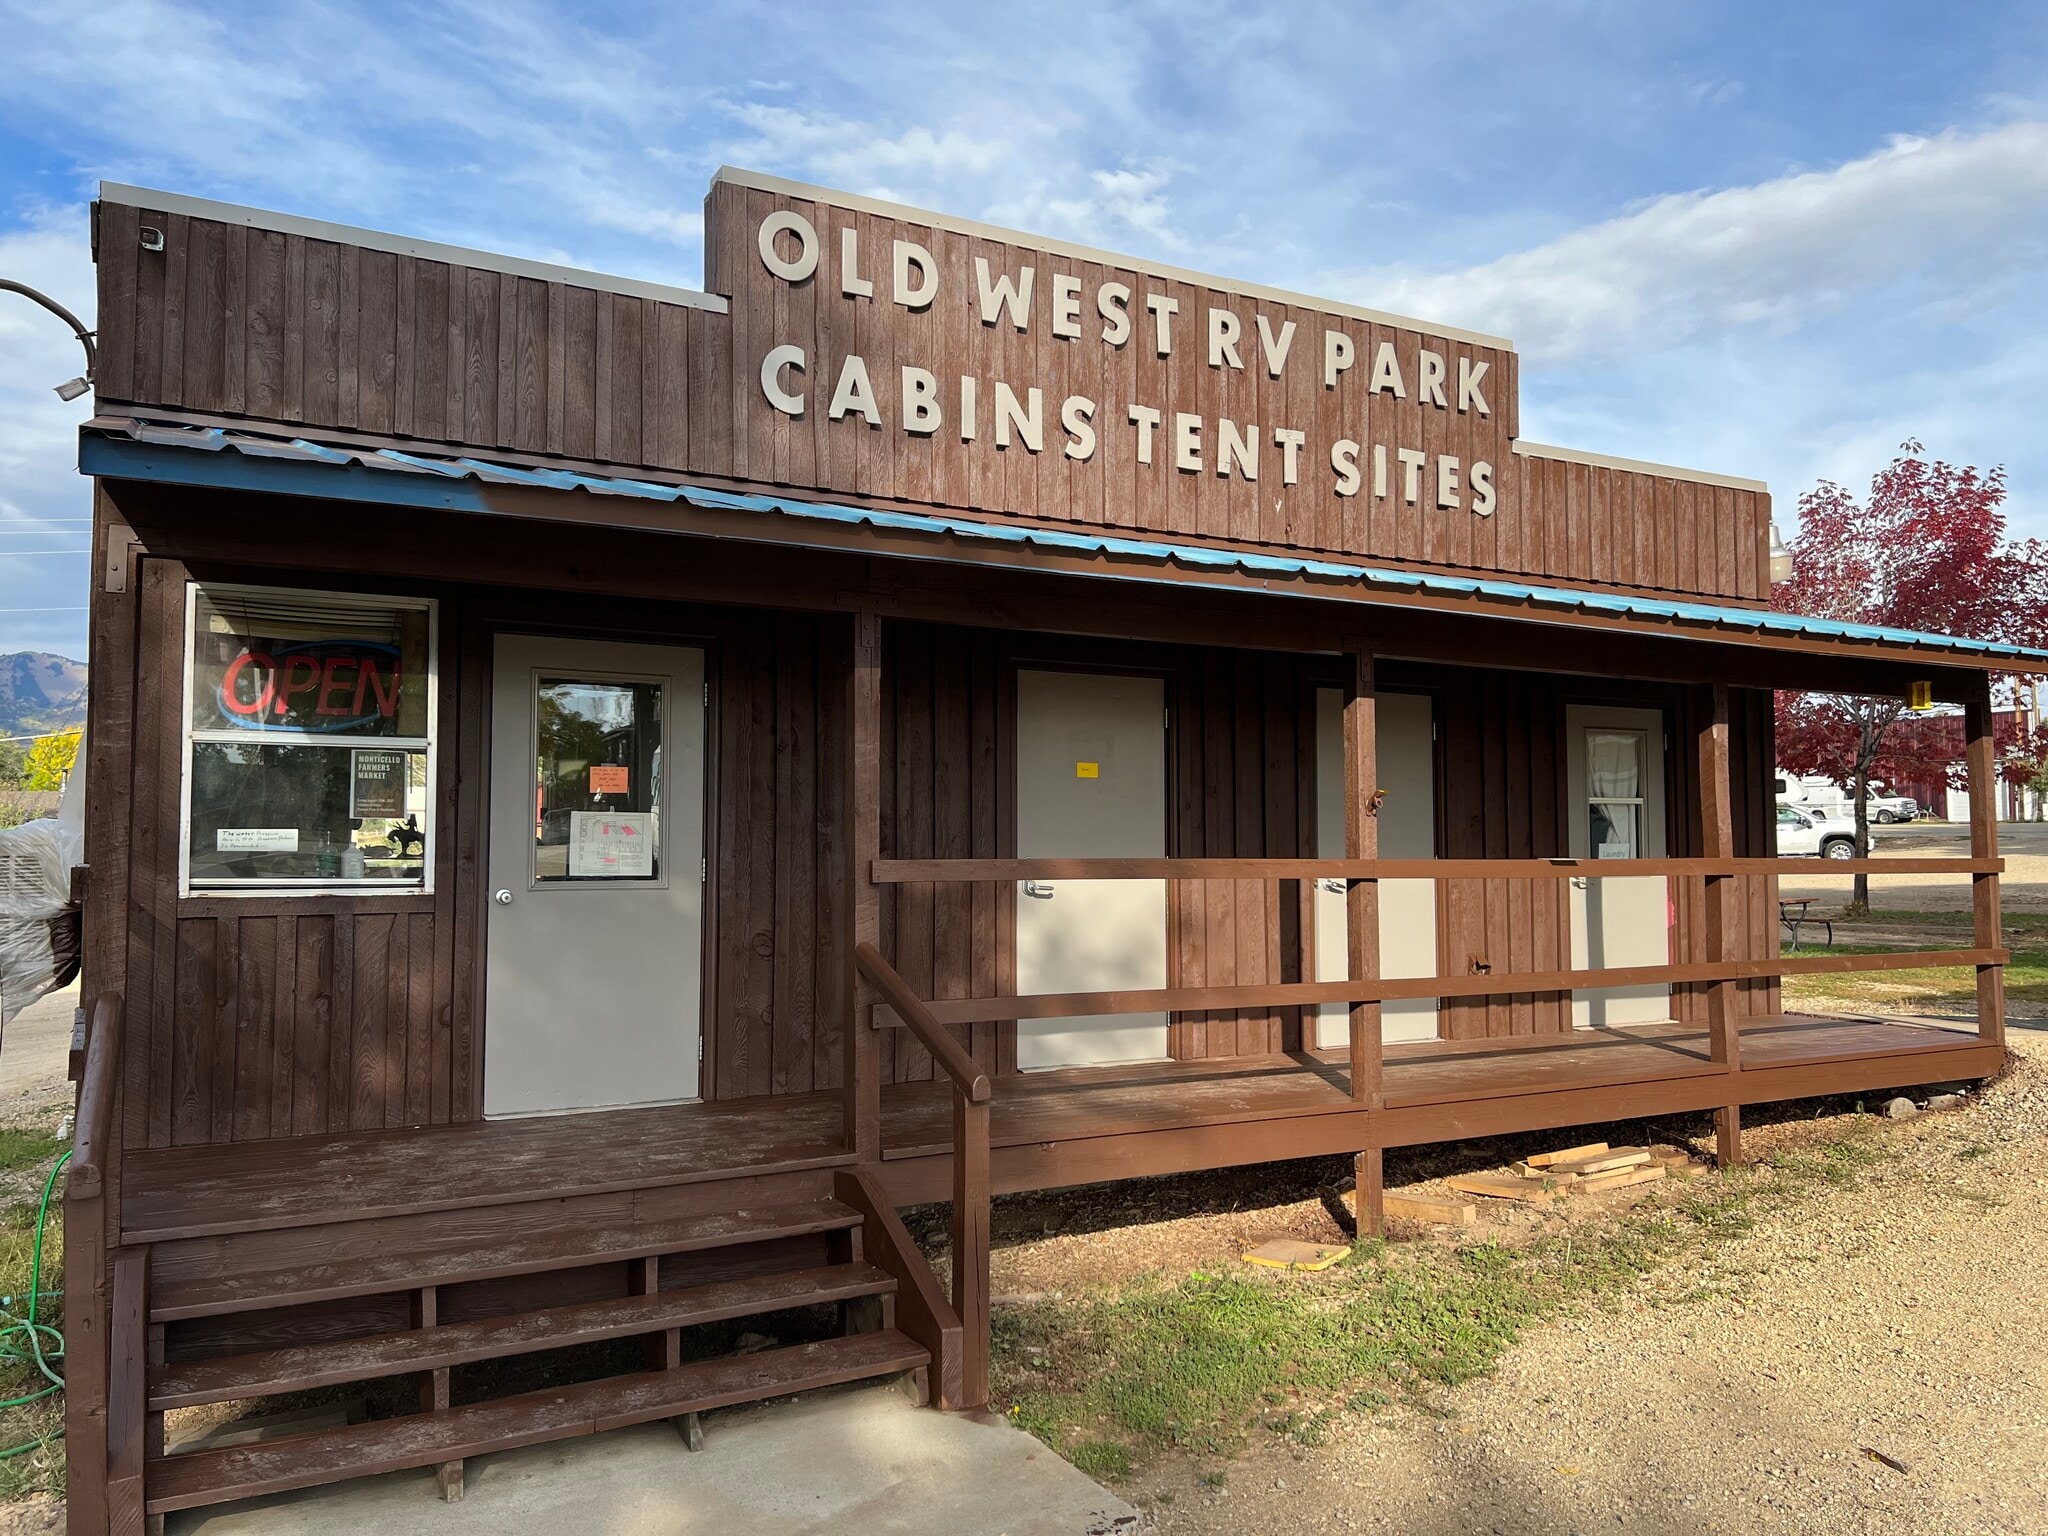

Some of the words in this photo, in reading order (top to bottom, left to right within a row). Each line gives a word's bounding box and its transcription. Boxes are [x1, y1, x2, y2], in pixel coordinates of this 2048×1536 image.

[758, 209, 939, 309] OLD
[974, 256, 1179, 355] WEST
[1209, 307, 1297, 376] RV
[1323, 328, 1491, 415] PARK
[760, 344, 1097, 461] CABINS
[1128, 404, 1305, 485] TENT
[1331, 438, 1498, 517] SITES
[223, 651, 402, 717] OPEN
[1603, 850, 1626, 859] Laundry
